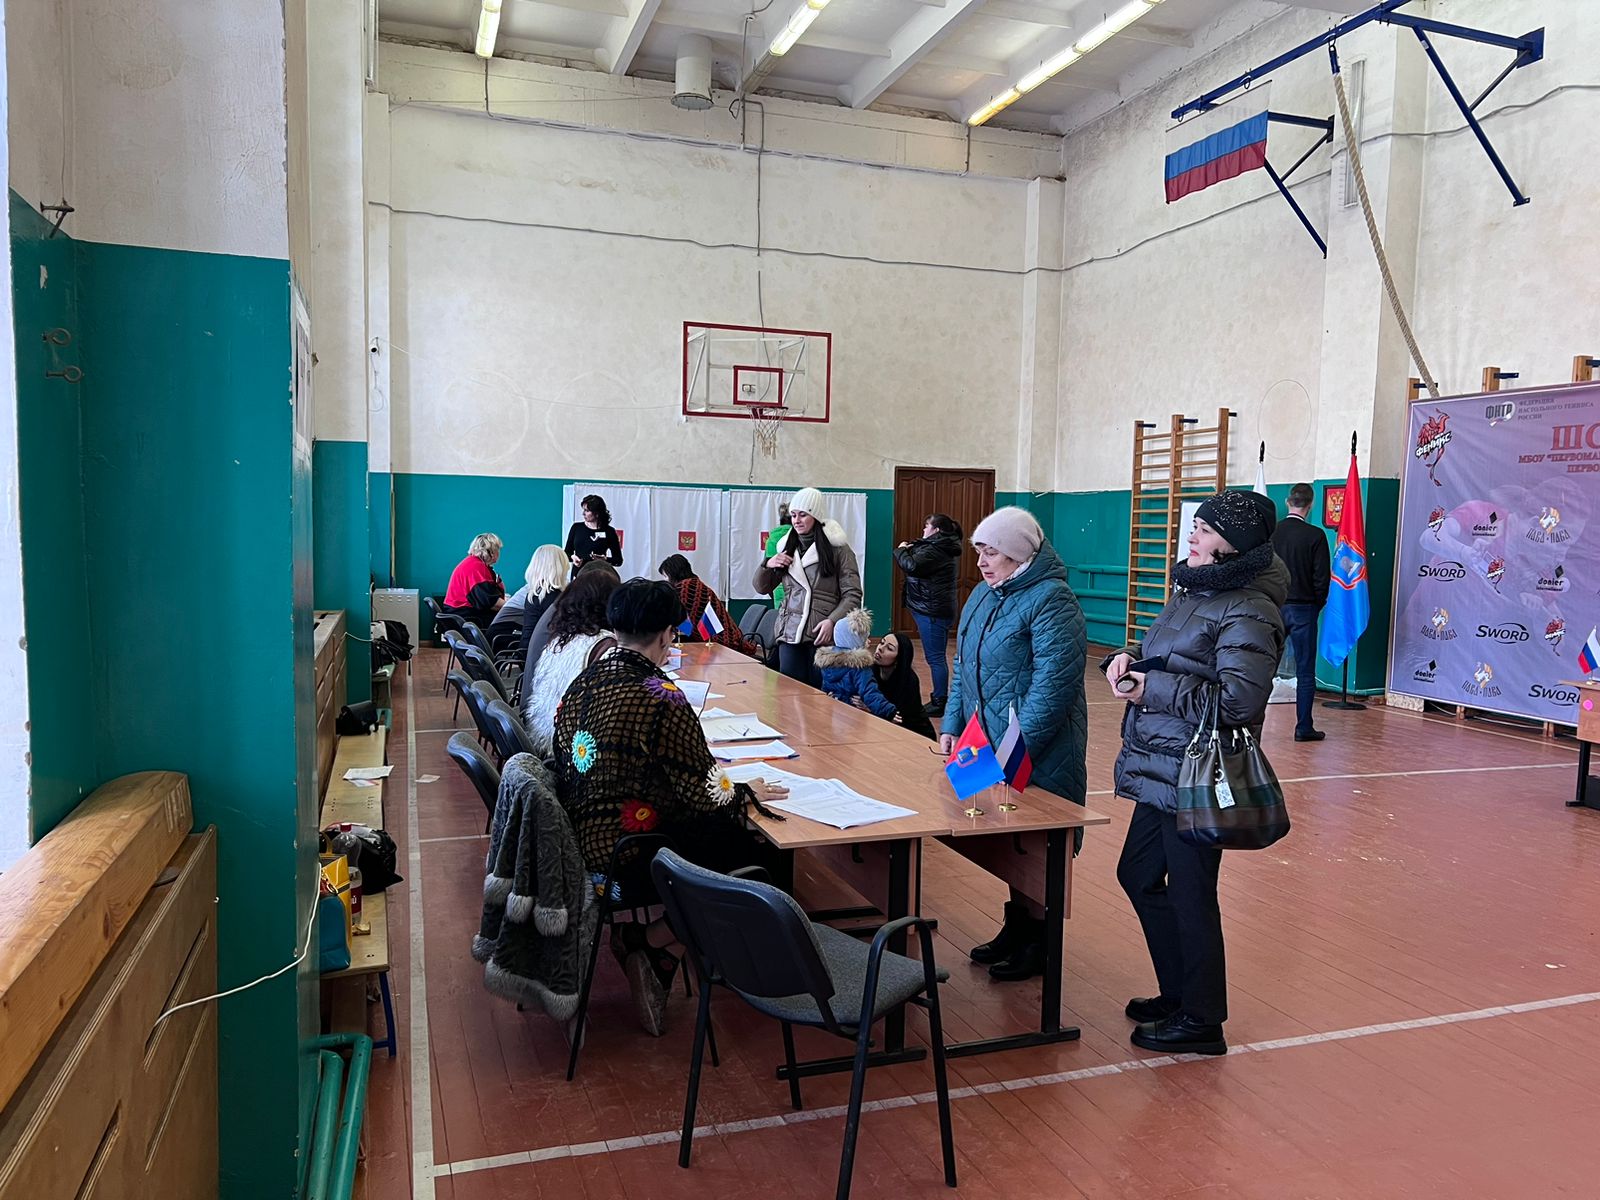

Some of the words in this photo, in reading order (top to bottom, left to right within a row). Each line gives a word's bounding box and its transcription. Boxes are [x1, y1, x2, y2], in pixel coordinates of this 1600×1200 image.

[1485, 403, 1513, 419] ФНТР
[1518, 454, 1545, 463] МБОУ
[1567, 463, 1600, 473] ПЕРВО
[1418, 564, 1466, 579] SWORD
[1475, 624, 1530, 642] SWORD
